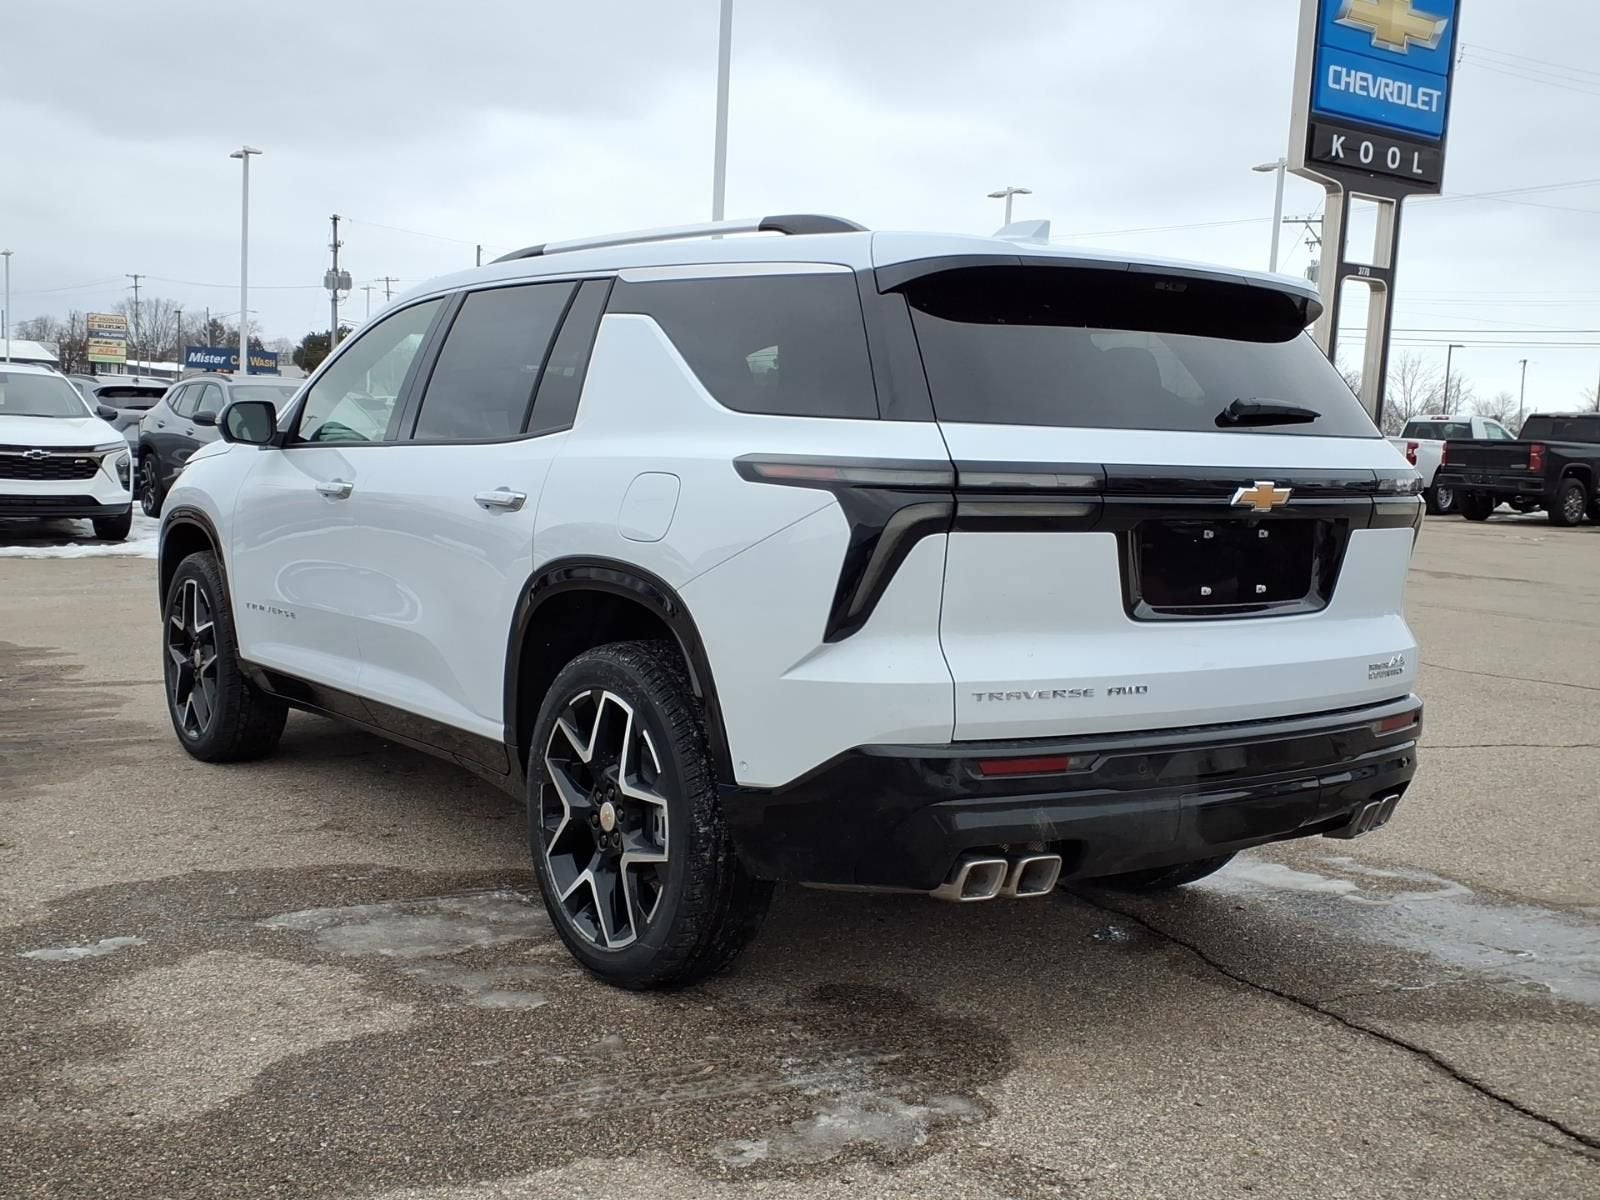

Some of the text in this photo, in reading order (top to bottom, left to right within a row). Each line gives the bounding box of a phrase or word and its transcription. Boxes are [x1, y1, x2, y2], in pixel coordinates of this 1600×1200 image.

[1327, 64, 1442, 113] CHEVROLET
[1331, 134, 1423, 174] KOOL
[188, 352, 227, 364] Mister
[249, 356, 276, 368] WASH
[972, 685, 1148, 702] TRAVERSE AWD
